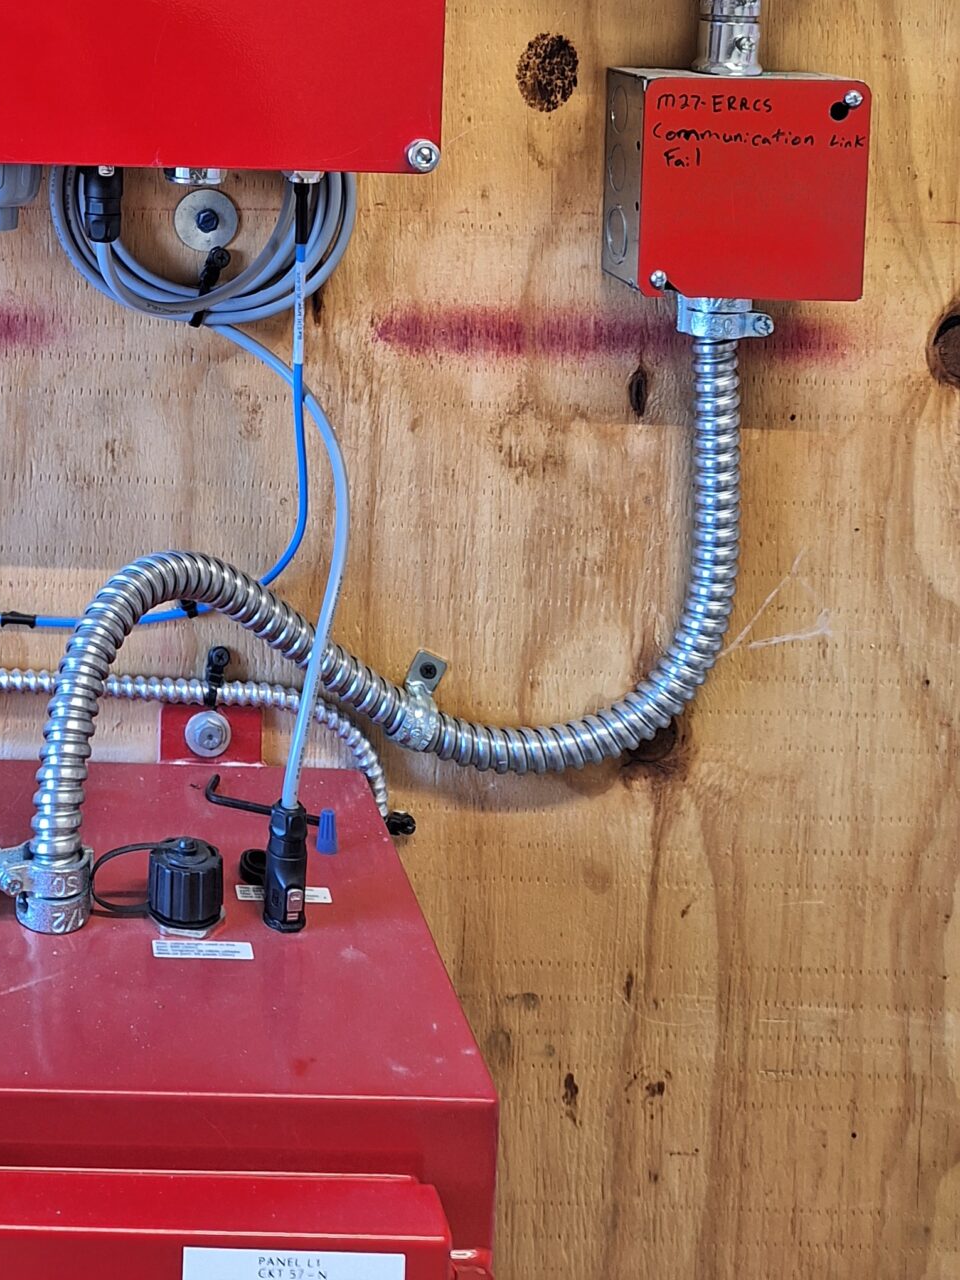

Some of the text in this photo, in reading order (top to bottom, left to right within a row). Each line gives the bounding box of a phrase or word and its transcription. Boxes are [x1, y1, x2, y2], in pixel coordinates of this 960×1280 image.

[652, 122, 815, 147] Communication
[663, 147, 702, 168] Fail
[257, 1256, 301, 1267] PANEL
[257, 1267, 284, 1279] CKT
